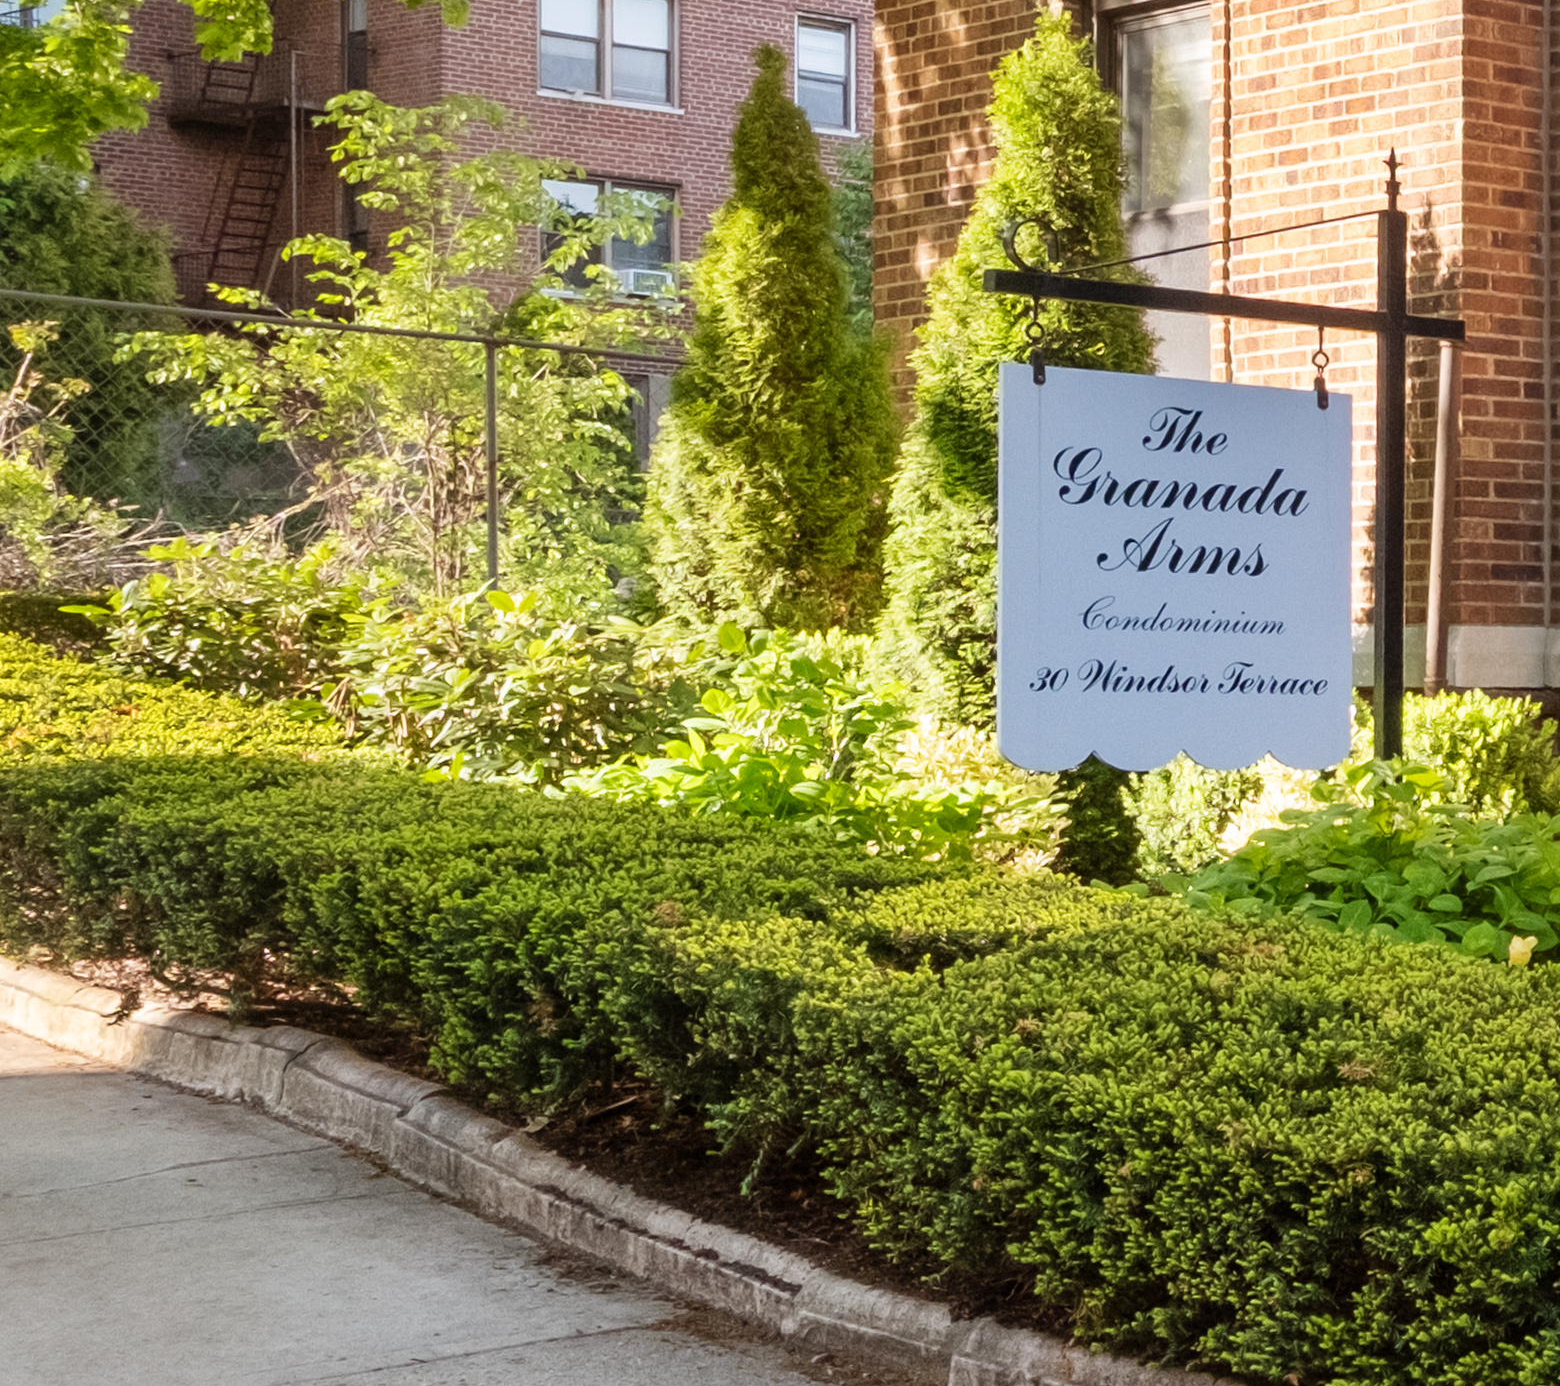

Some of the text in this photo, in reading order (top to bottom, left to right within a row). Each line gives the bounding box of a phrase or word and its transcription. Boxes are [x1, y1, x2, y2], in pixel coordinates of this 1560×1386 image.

[1141, 406, 1228, 456] The
[1052, 446, 1310, 517] Granada
[1095, 517, 1270, 577] Arms
[1078, 595, 1286, 635] Condominium
[1029, 658, 1329, 696] 30 Windsor Terrace
